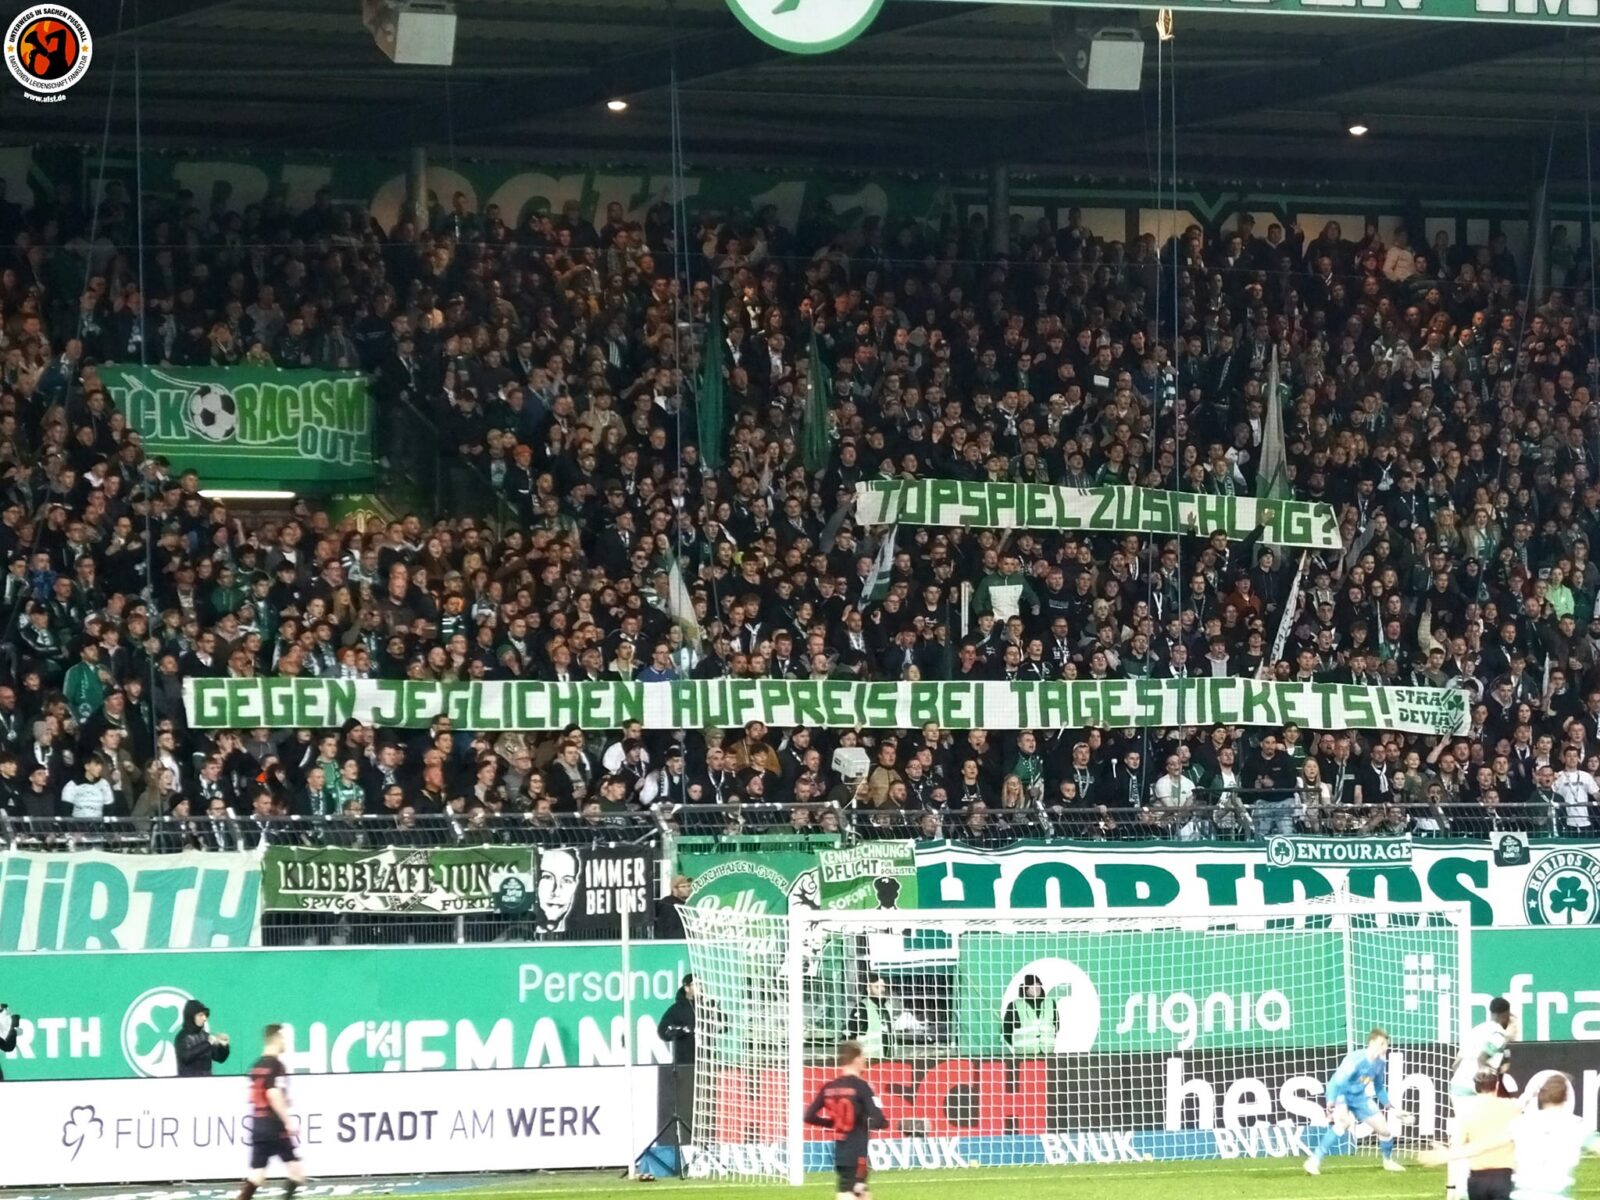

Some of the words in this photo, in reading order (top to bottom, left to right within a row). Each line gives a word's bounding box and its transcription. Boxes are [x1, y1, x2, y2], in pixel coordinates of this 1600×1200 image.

[106, 386, 190, 440] ICK
[232, 377, 368, 444] RACISM
[193, 679, 358, 727] GEGEN
[371, 680, 644, 729] JEGLICHEN
[671, 680, 898, 728] AUFPREIS
[909, 682, 985, 728] BEI
[1010, 678, 1393, 728] TAGESTICKETS!
[825, 860, 878, 881] PFLICHT
[1297, 843, 1412, 860] ENTOURAGE
[585, 857, 646, 888] IMMER
[1529, 853, 1583, 891] HORIDOS
[586, 889, 611, 915] BEI
[615, 887, 647, 914] UNS
[519, 960, 684, 1003] Personal
[1115, 989, 1291, 1051] signia
[116, 1110, 179, 1149] FÜR
[336, 1110, 439, 1143] STADT
[450, 1109, 494, 1140] AM
[506, 1105, 601, 1138] WERK
